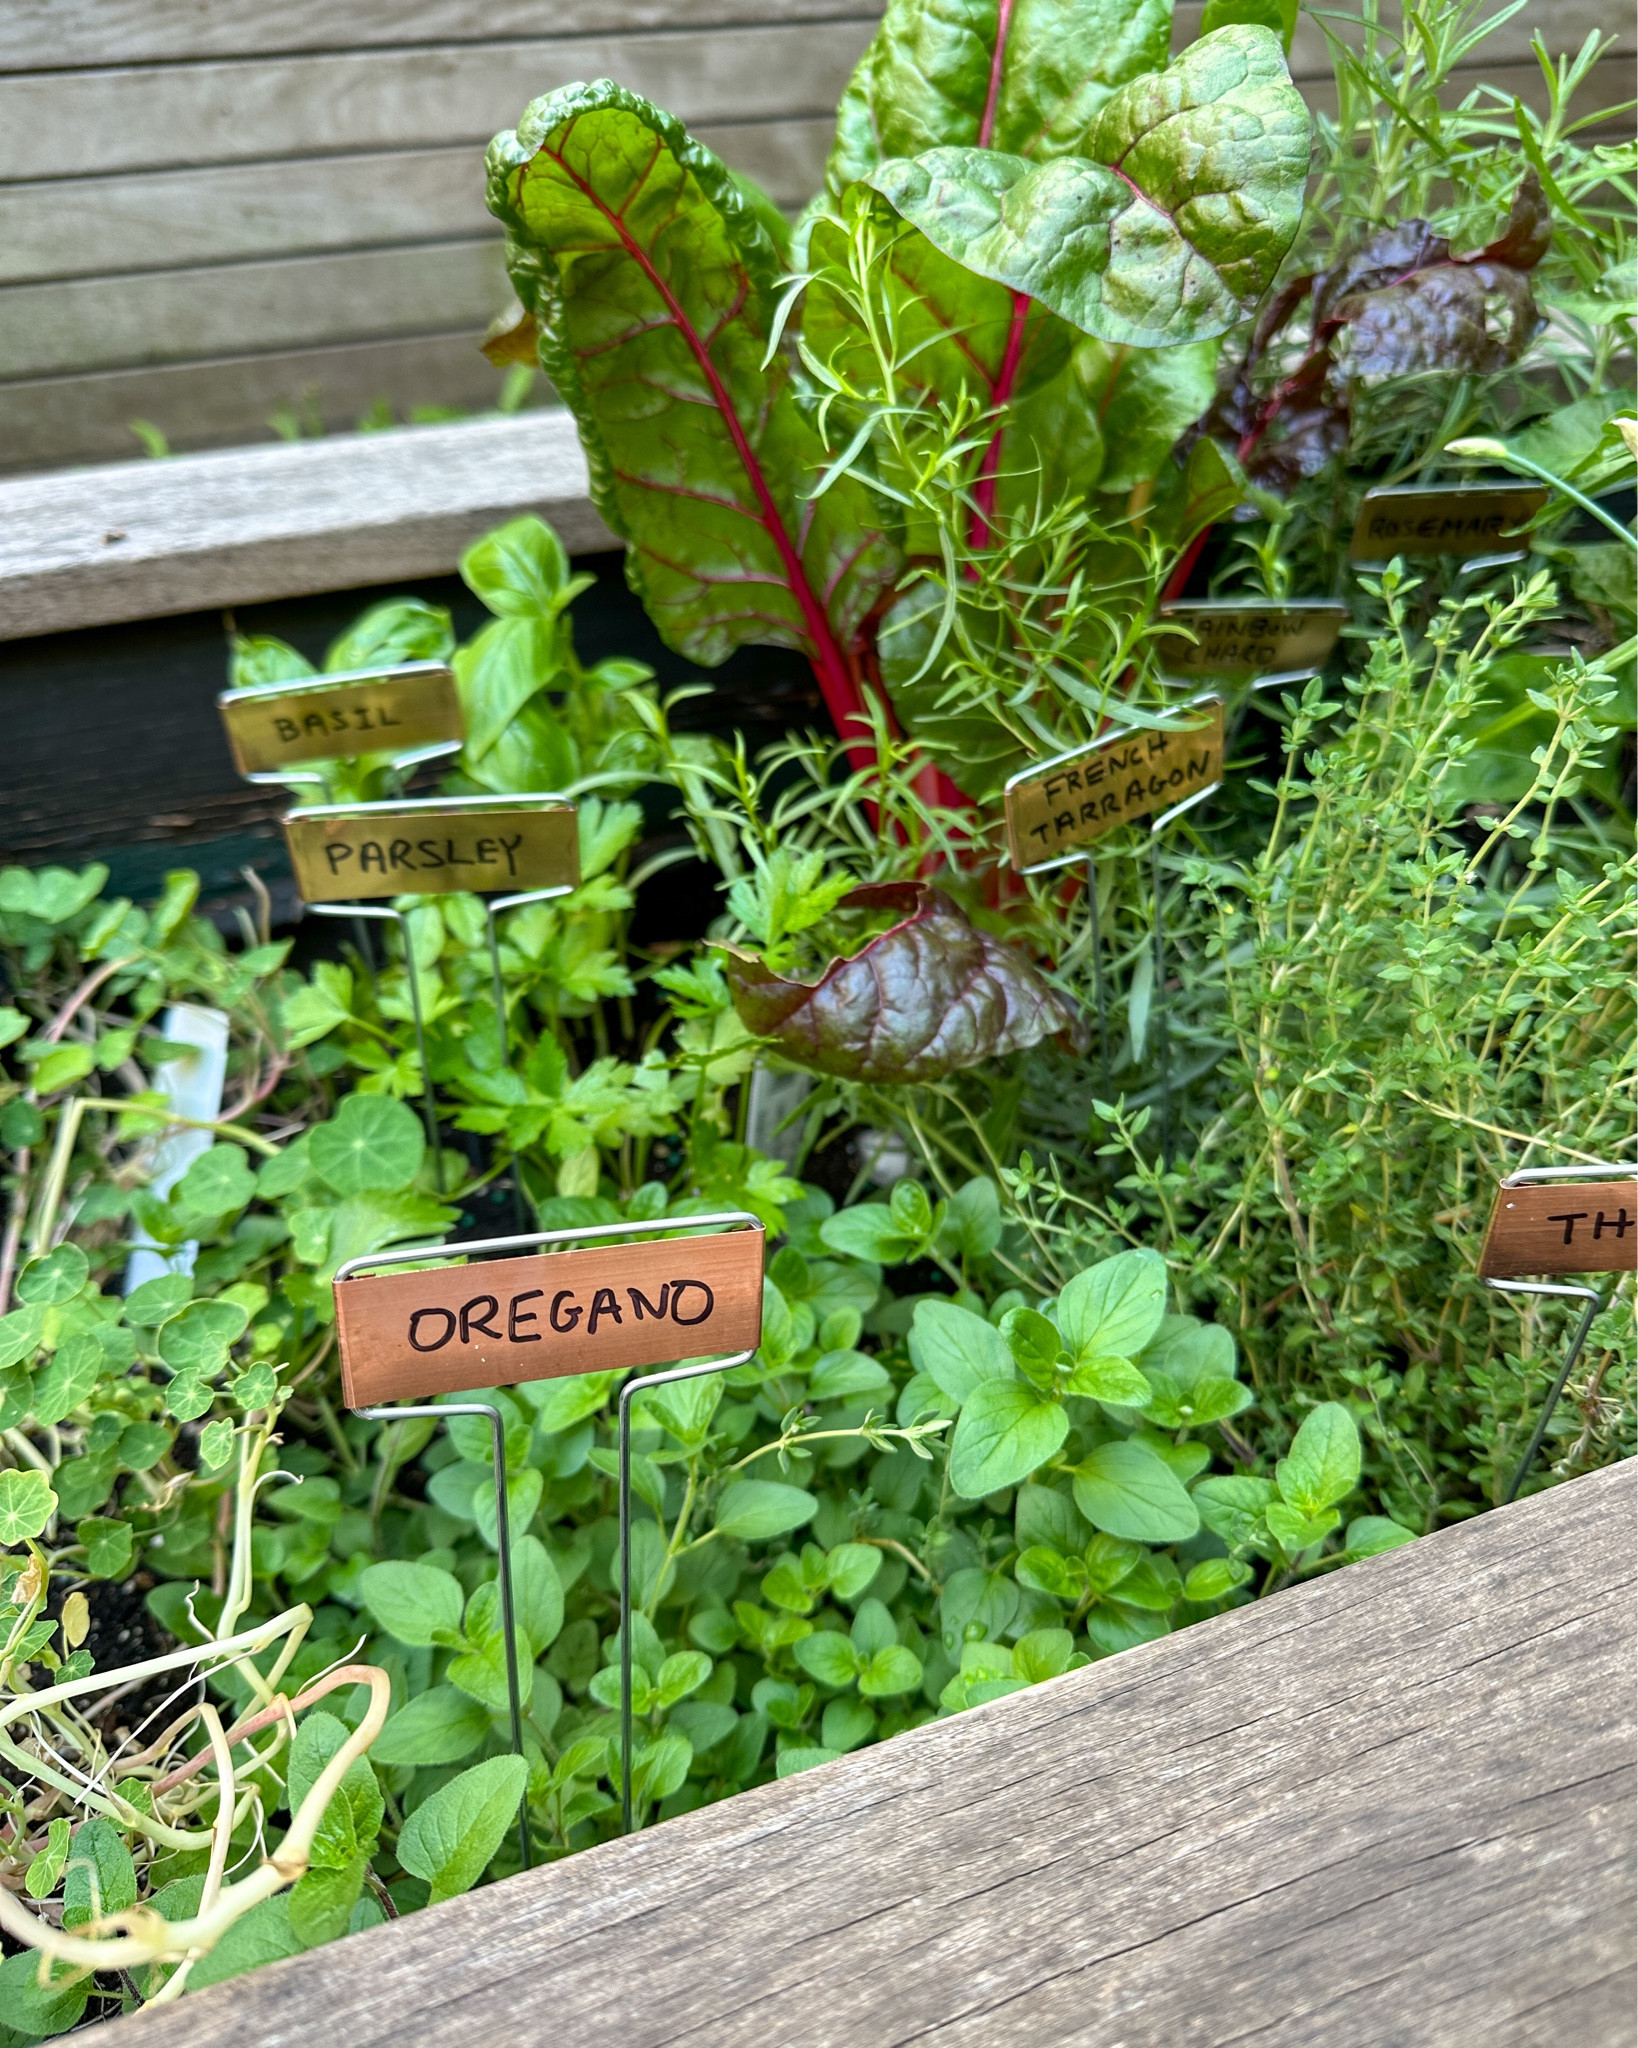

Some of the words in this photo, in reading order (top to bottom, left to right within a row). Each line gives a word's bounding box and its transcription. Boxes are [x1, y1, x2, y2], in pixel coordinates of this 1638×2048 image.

[272, 706, 401, 742] BASIL
[1043, 732, 1168, 805] FRENCH
[1029, 750, 1210, 845] TARRAGON
[325, 834, 523, 876] PARSLEY
[1546, 1208, 1635, 1245] TH
[407, 1279, 715, 1352] OREGANO
